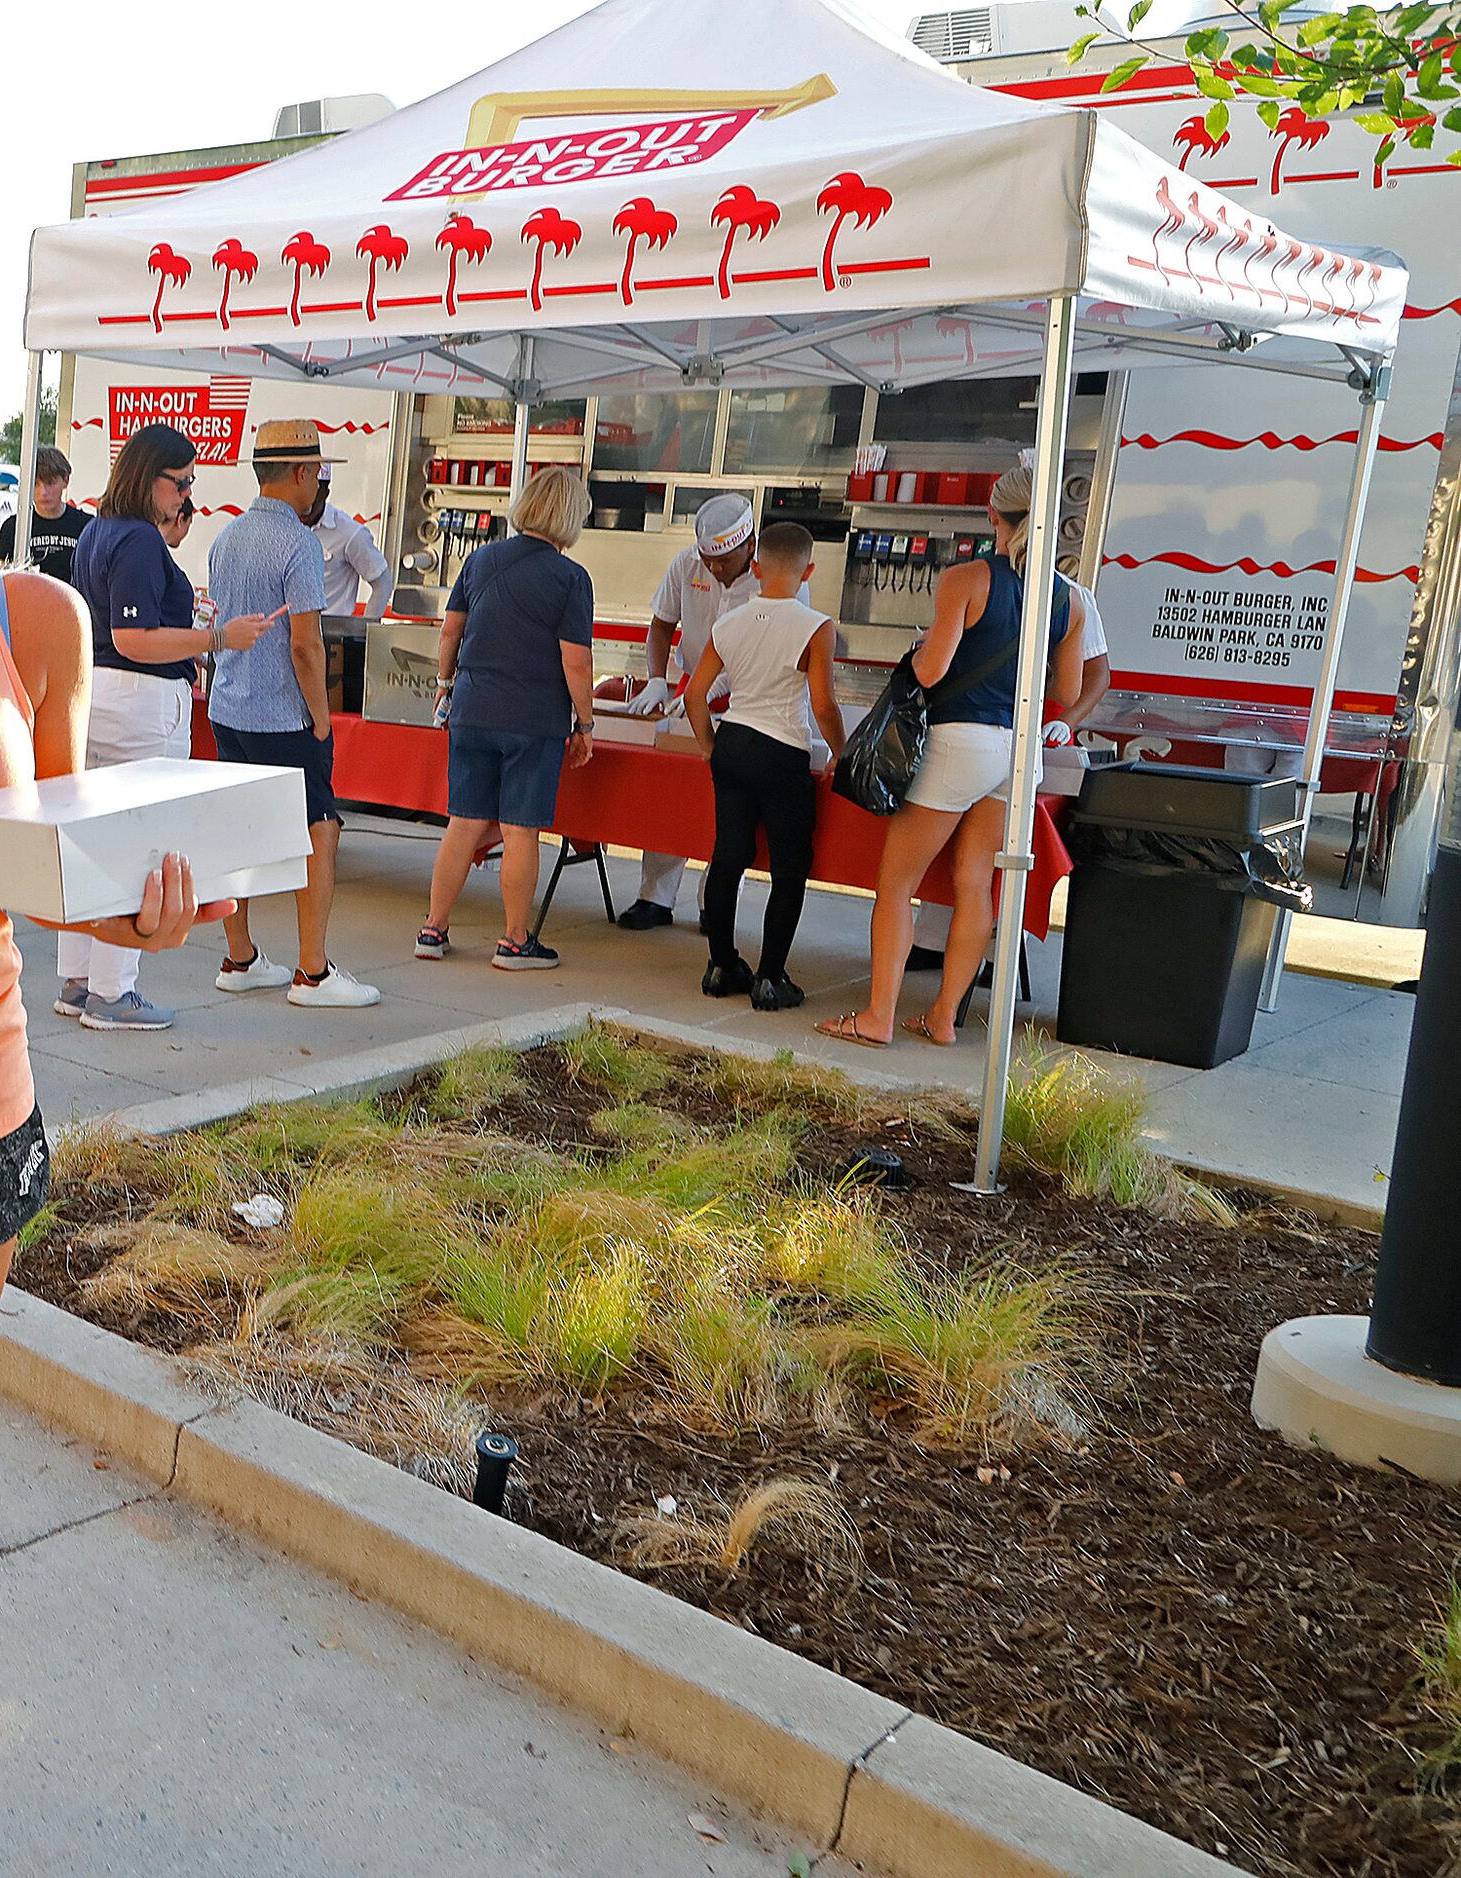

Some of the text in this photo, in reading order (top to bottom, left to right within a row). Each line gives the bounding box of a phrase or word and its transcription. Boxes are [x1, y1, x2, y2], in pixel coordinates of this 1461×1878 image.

[433, 115, 737, 176] IN-N-OUT
[402, 144, 699, 198] BURGER
[116, 392, 198, 413] IN-N-OUT
[1164, 587, 1229, 606] IN-N-OUT
[1233, 592, 1295, 612] BURGER,
[1157, 606, 1197, 623] 13502
[1201, 609, 1291, 629] HAMBURGER
[1151, 624, 1214, 642] BALDWIN
[1219, 629, 1260, 648] PARK,
[1265, 633, 1285, 648] CA
[1184, 644, 1291, 667] (626) 813-8295
